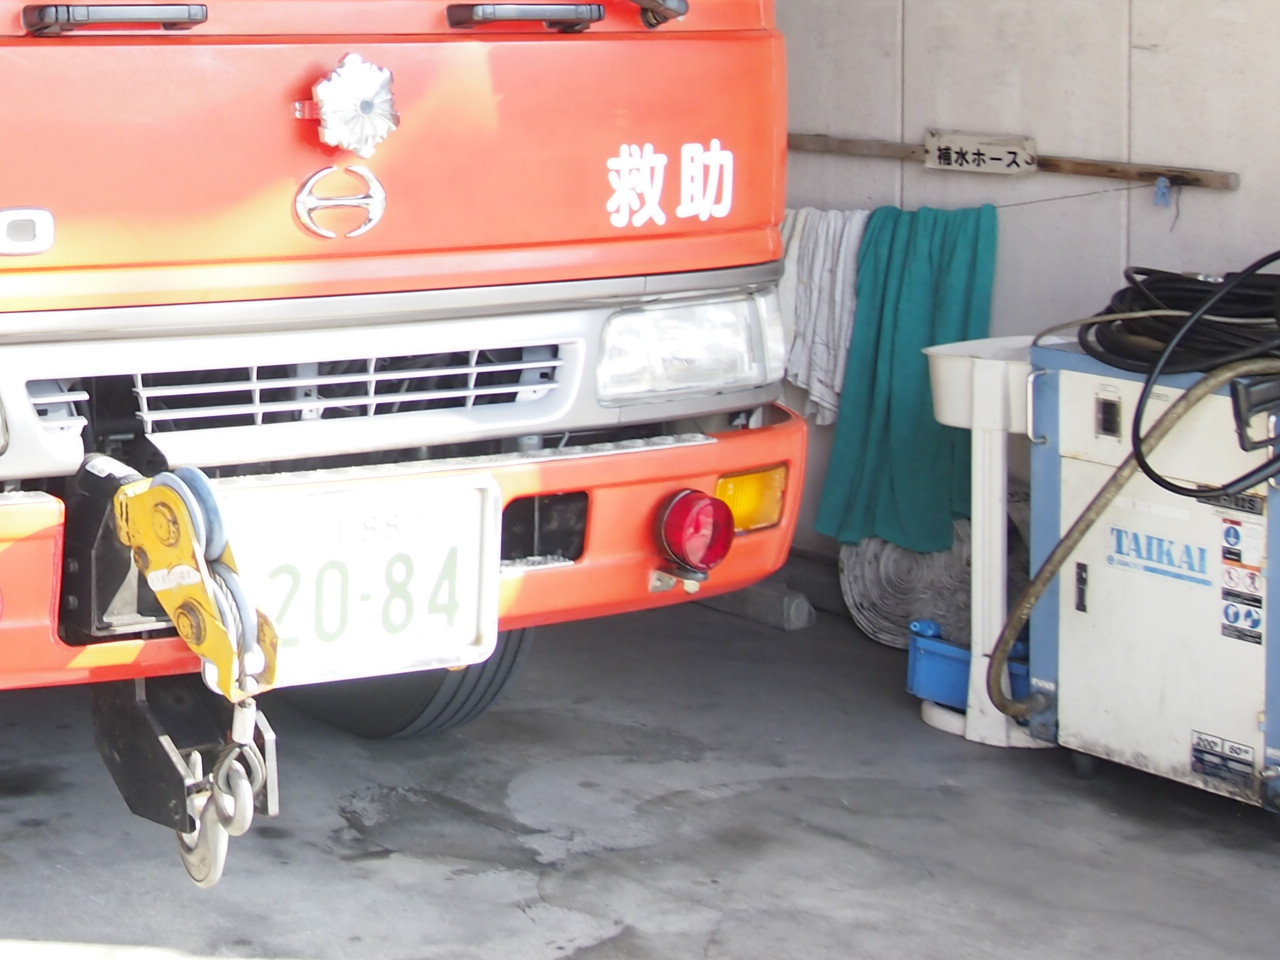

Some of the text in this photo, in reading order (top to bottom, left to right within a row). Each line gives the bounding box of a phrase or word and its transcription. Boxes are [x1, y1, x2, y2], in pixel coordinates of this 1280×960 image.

[936, 144, 1021, 168] 補水ホース
[606, 138, 734, 228] 救助
[1110, 526, 1208, 575] TAIKAI
